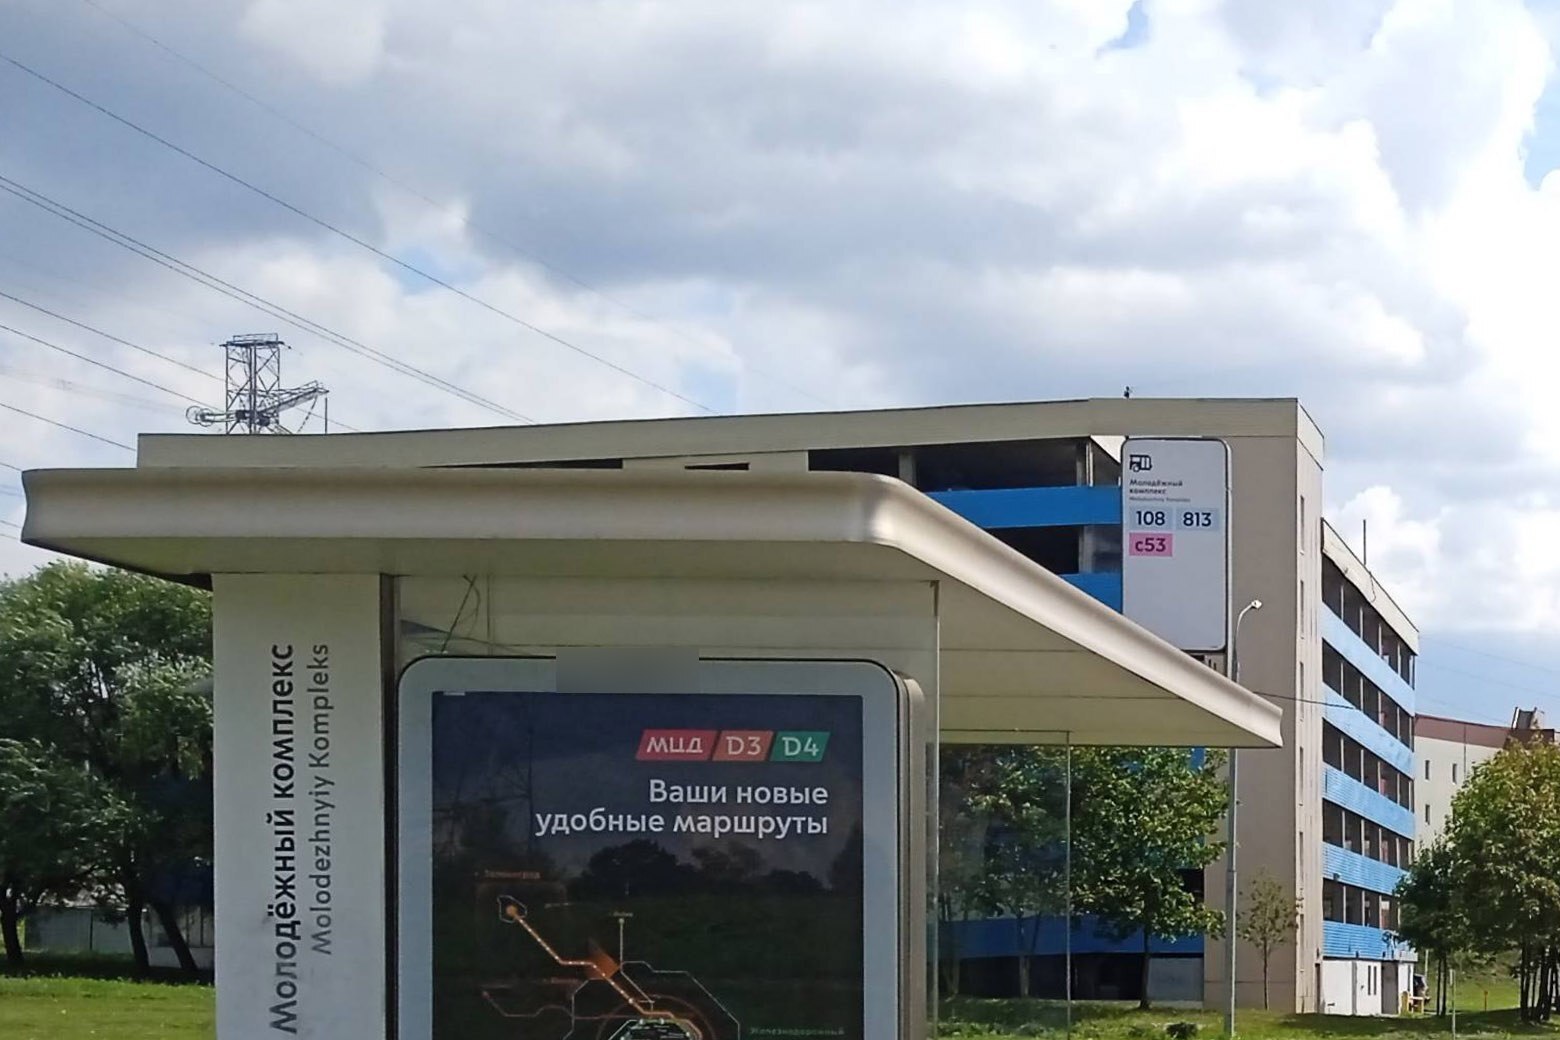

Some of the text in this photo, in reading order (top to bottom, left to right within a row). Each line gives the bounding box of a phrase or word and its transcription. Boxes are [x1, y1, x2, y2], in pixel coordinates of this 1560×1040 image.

[1136, 510, 1212, 527] 108 813
[646, 736, 820, 757] МЦД D3 D4
[306, 643, 336, 955] Molodezhnyiy Kompleks
[649, 778, 829, 805] Ваши новые
[535, 807, 828, 840] удобные маршруты
[267, 643, 301, 1035] Молодёжный комплекс
